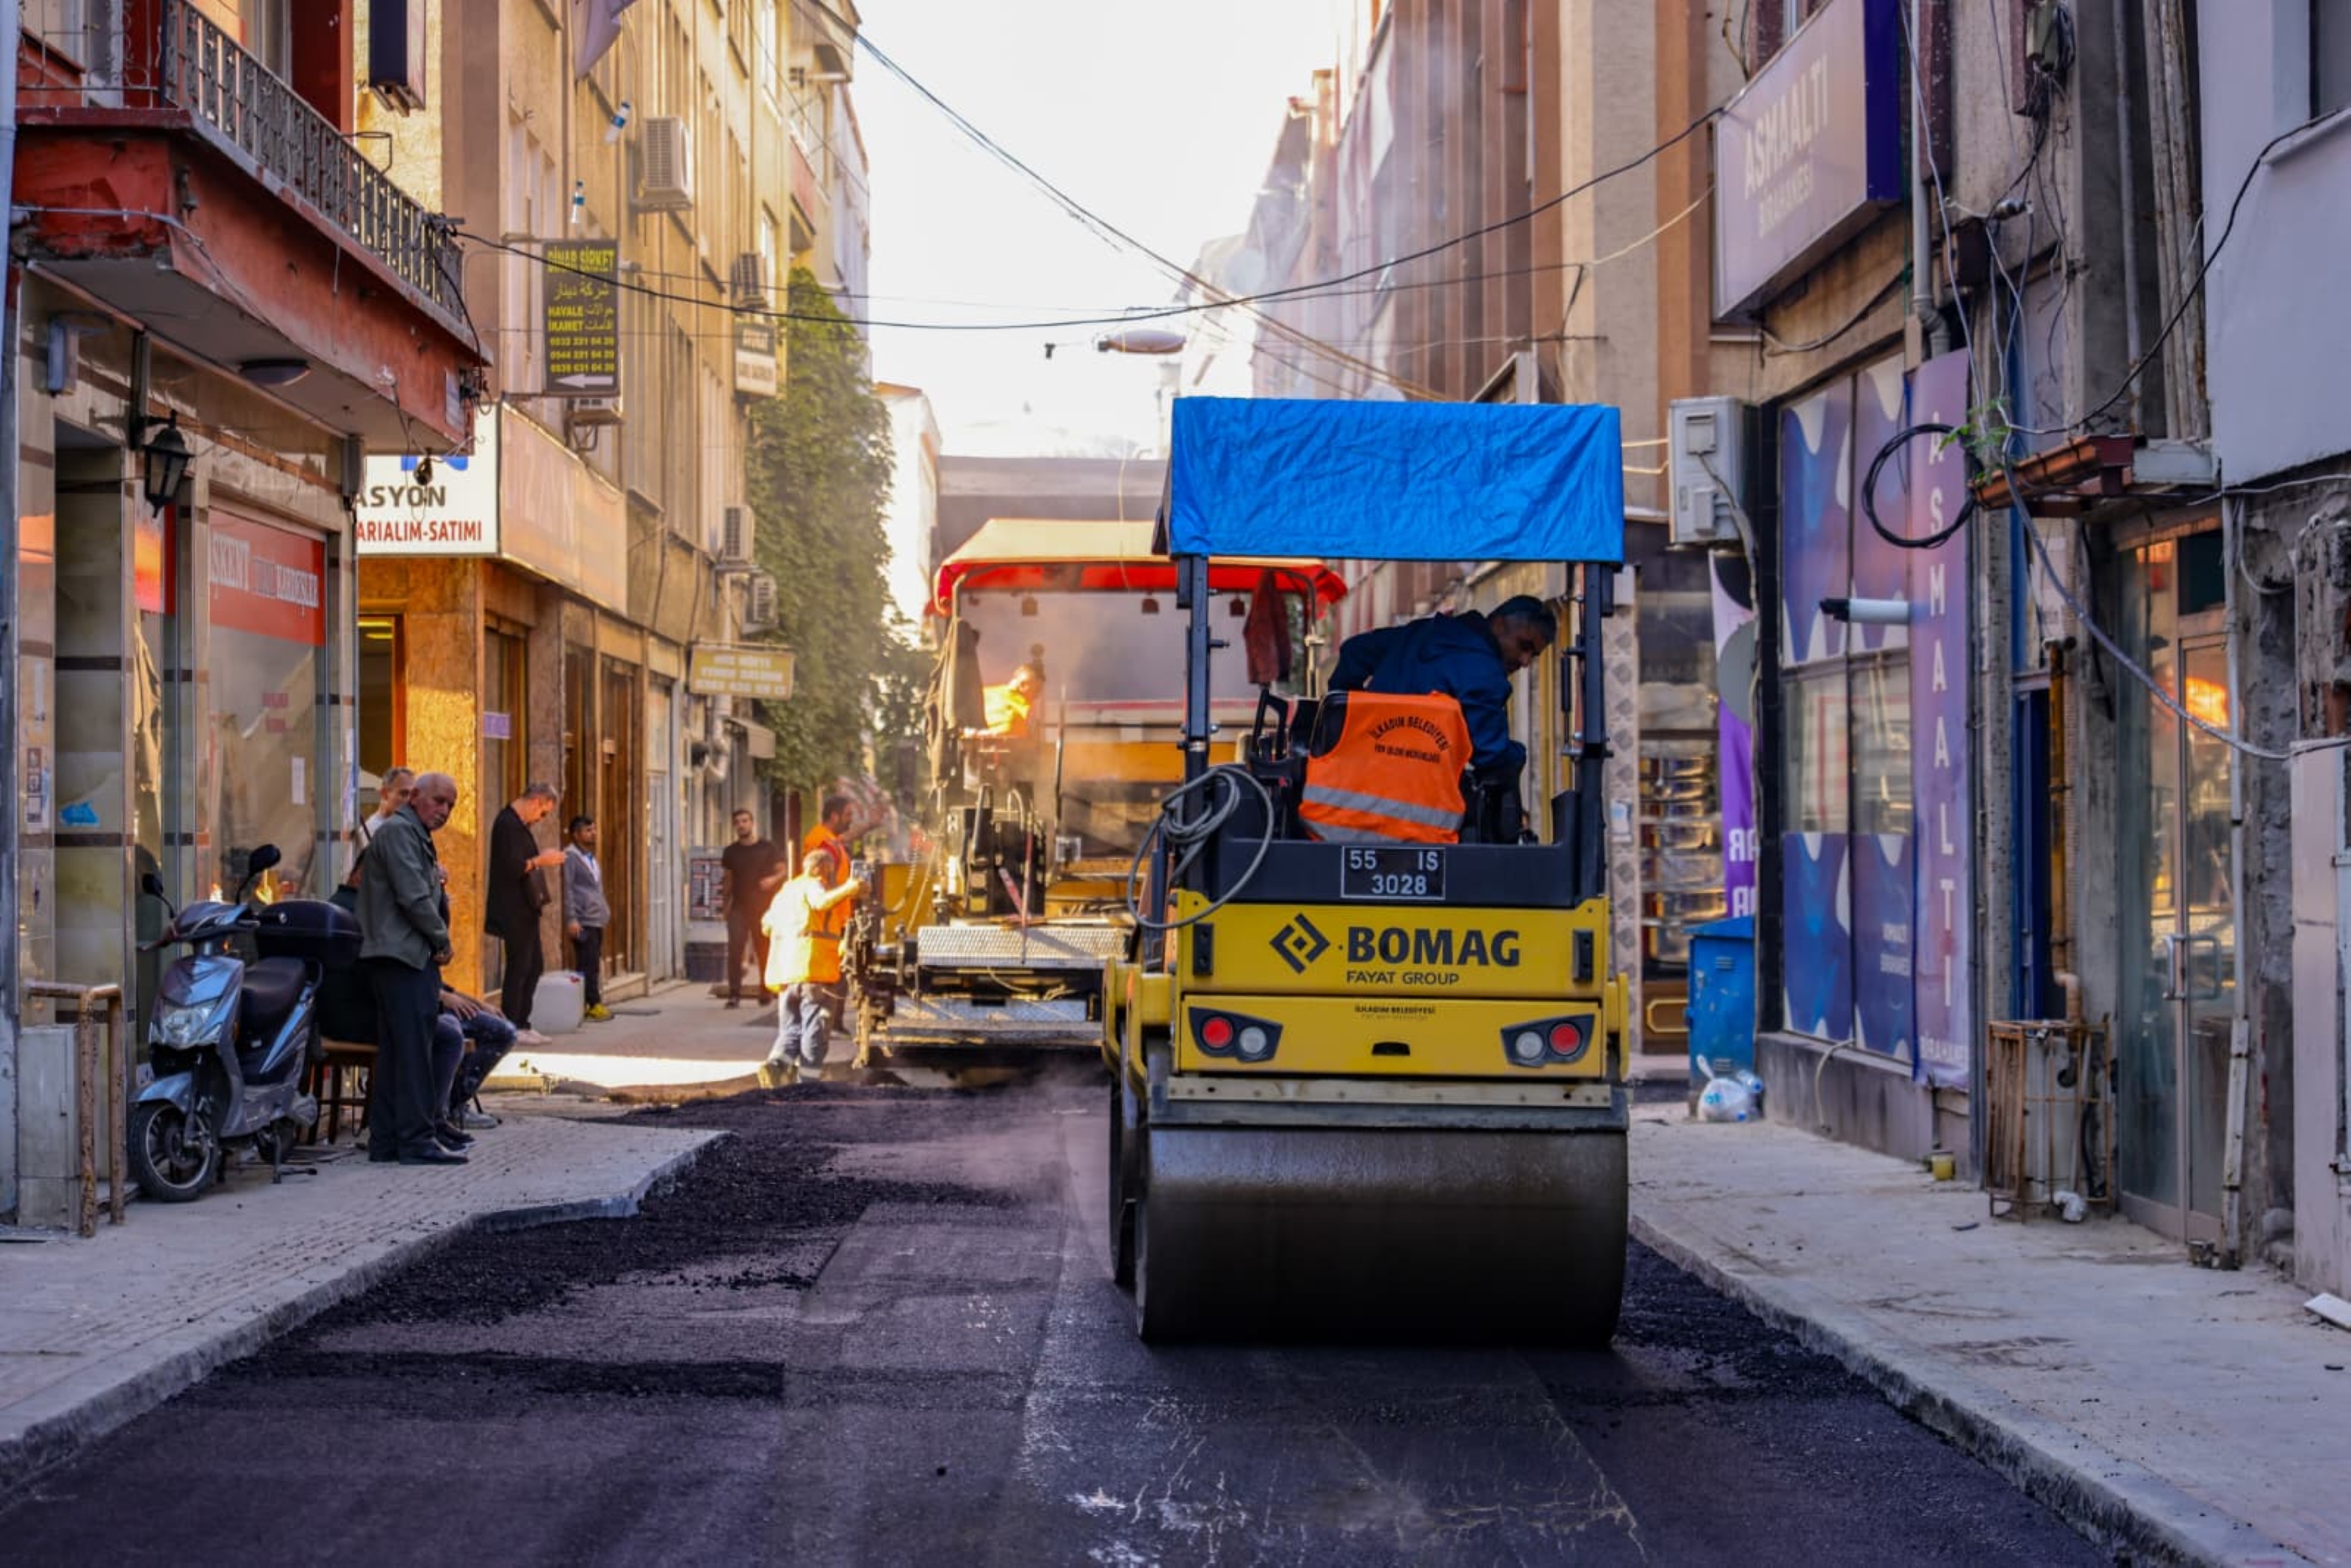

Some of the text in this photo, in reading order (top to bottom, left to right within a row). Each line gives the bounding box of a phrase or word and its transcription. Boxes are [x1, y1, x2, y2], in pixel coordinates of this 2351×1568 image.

[1744, 52, 1829, 200] ASMAALTI
[1350, 849, 1377, 870] 55
[1371, 873, 1428, 895] 3028
[1347, 927, 1521, 967] BOMAG
[1346, 971, 1460, 985] FAYAT GROUP
